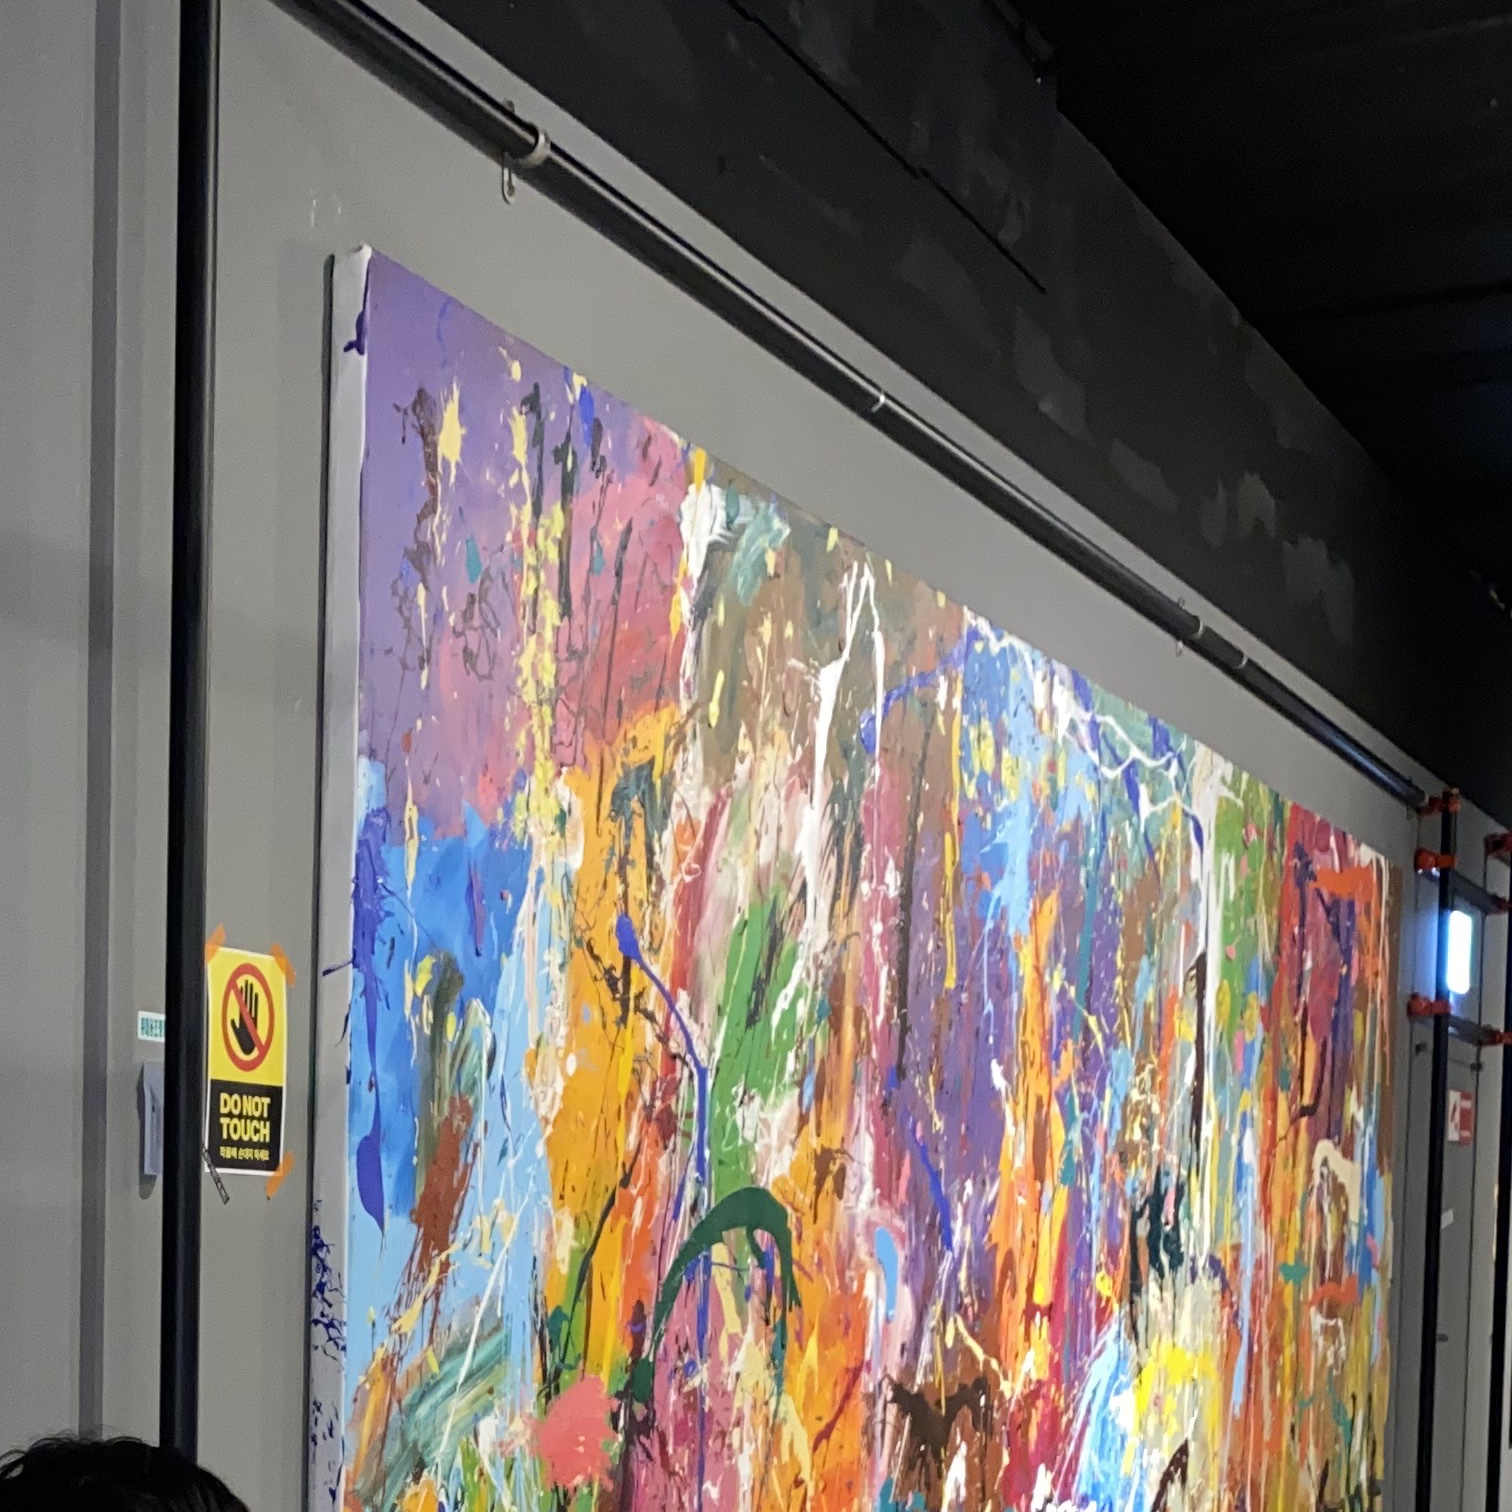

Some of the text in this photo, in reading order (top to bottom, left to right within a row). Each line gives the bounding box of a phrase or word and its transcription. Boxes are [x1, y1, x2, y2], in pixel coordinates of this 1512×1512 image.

[219, 1092, 271, 1118] DO NOT
[219, 1117, 270, 1143] TOUCH
